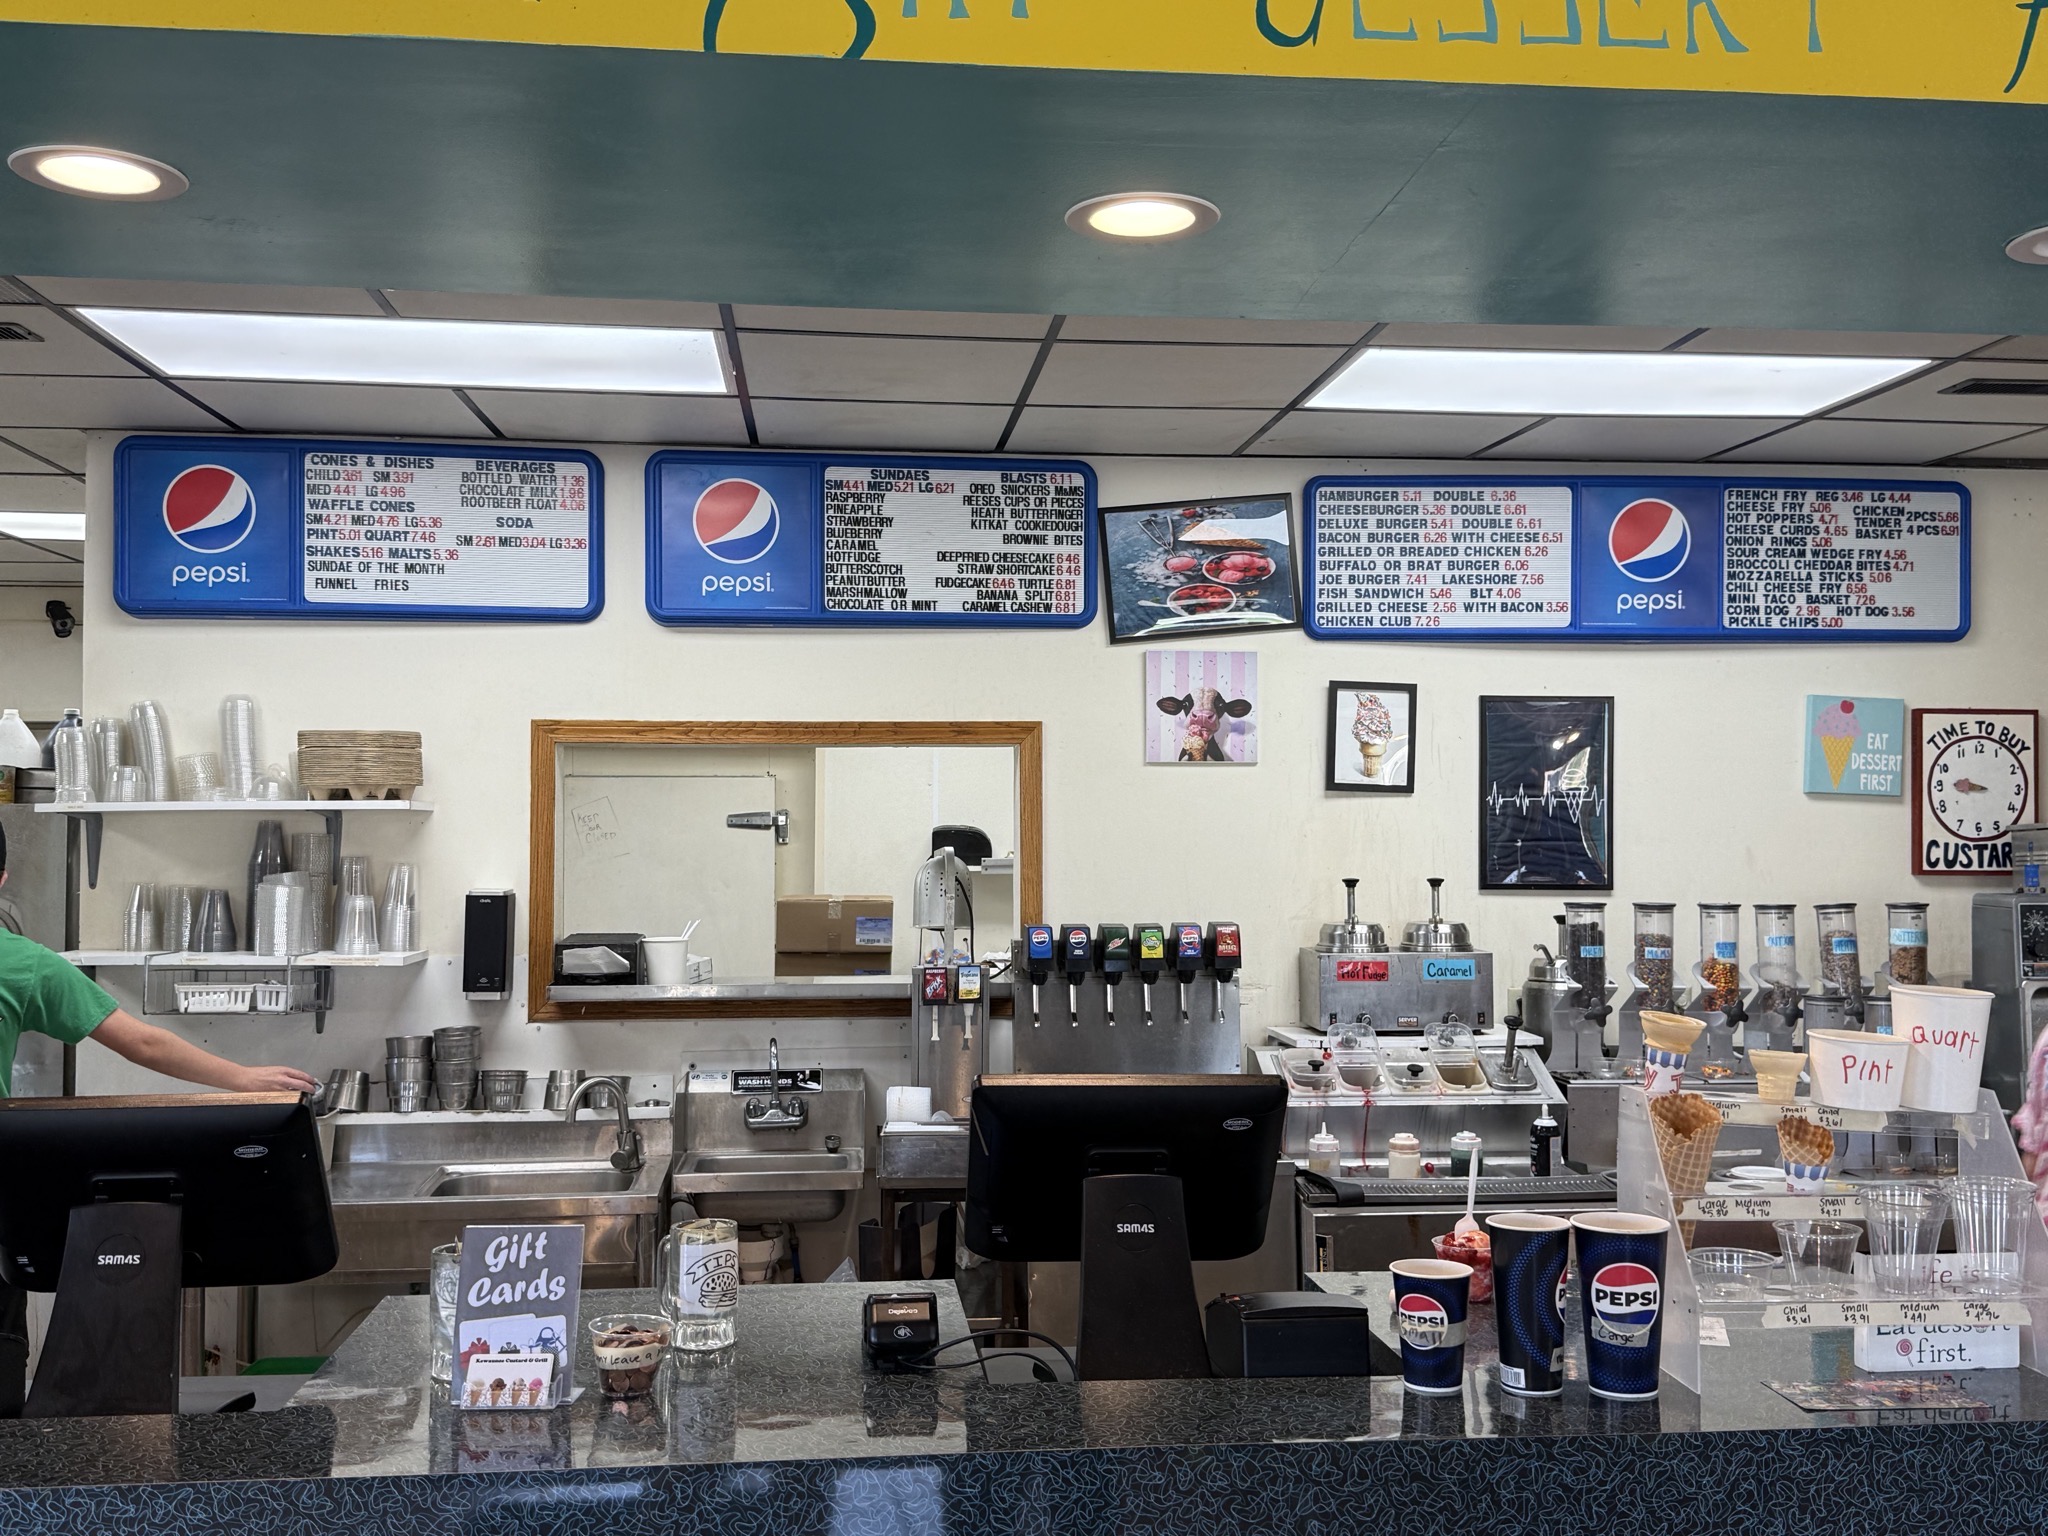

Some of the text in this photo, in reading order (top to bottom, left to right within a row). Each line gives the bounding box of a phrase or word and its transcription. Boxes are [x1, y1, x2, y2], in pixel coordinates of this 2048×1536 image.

[310, 454, 434, 469] CONES & DISHES
[476, 460, 555, 474] BEVERAGES
[870, 469, 930, 481] SUNDAES
[1001, 472, 1047, 484] BLASTS
[969, 483, 1084, 497] OREO SNICKERS M&MS
[1319, 490, 1399, 501] HAMBURGER
[1433, 490, 1485, 501] DOUBLE
[825, 491, 886, 504] RASPBERRY
[963, 495, 1084, 509] REESES CUPS OR PIECES
[308, 499, 415, 512] WAFFLE CONES
[826, 503, 883, 516] PINEAPPLE
[1319, 504, 1419, 515] CHEESEBURGER
[1451, 504, 1501, 515] DOUBLE
[1727, 501, 1775, 512] CHEESE
[1781, 502, 1805, 513] FRY
[496, 517, 534, 529] SODA
[826, 515, 894, 528] STRAWBERRY
[1727, 513, 1751, 524] HOT
[1756, 513, 1814, 524] POPPERS
[307, 528, 338, 540] PINT
[364, 529, 409, 541] QUART
[826, 527, 883, 539] BLUEBERRY
[1726, 524, 1774, 536] CHEESE
[1780, 524, 1820, 536] CURDS
[1318, 532, 1361, 543] BACON
[1367, 532, 1420, 543] BURGER
[1451, 532, 1485, 543] WITH
[1490, 532, 1540, 543] CHEESE
[1725, 536, 1764, 546] ONION
[1770, 536, 1807, 547] RINGS
[826, 539, 879, 551] CARAMEL
[307, 560, 444, 574] SUNDAE OF THE MONTH
[825, 563, 903, 575] BUTTERSCOTCH
[1319, 560, 1377, 571] BUFFALO
[1383, 560, 1402, 571] OR
[1407, 560, 1442, 571] BRAT
[1447, 560, 1500, 571] BURGER
[1727, 559, 1790, 570] BROCCOLI
[1794, 559, 1852, 571] CHEDDAR
[1856, 561, 1891, 571] BITES
[172, 562, 246, 587] pepsi
[825, 575, 906, 587] PEANUTBUTTER
[1318, 574, 1343, 585] JOE
[1348, 574, 1400, 585] BURGER
[1442, 574, 1518, 585] LAKESHORE
[315, 578, 409, 591] FUNNEL FRIES
[702, 572, 771, 596] pepsi
[826, 587, 908, 599] MARSHMALLOW
[826, 599, 938, 611] CHOCOLATE OR MINT
[1617, 589, 1683, 614] pepsi
[1726, 605, 1760, 616] CORN
[1764, 605, 1790, 616] DOG
[1836, 606, 1861, 616] HOT
[1865, 606, 1889, 617] DOG
[1317, 616, 1374, 627] CHICKEN
[1379, 616, 1412, 627] CLUB
[1867, 733, 1889, 750] EAT
[1927, 720, 2031, 756] TIME TO BUY
[1957, 748, 1965, 758] 11
[1975, 744, 1985, 754] 12
[1851, 753, 1902, 770] DESSERT
[1939, 763, 1949, 774] 10
[1860, 773, 1893, 792] FIRST
[1936, 780, 1944, 792] 9
[2014, 784, 2021, 796] 3
[1939, 800, 1947, 813] 8
[1975, 822, 1982, 833] 6
[1925, 839, 2013, 869] CUSTAR
[1362, 965, 1387, 981] Fudge
[1427, 962, 1472, 977] Caramel
[1912, 1026, 1979, 1059] Quart
[1842, 1054, 1893, 1084] Pint
[1698, 1200, 1728, 1210] Large
[1116, 1223, 1155, 1234] SAM4S
[485, 1231, 547, 1273] Gift
[97, 1254, 141, 1266] SAM4S
[697, 1253, 737, 1272] TIPS
[467, 1268, 566, 1308] Cards
[1595, 1288, 1657, 1307] PEPSI
[1783, 1304, 1807, 1315] Child
[1841, 1304, 1869, 1313] Small
[1963, 1302, 1990, 1312] Large
[1401, 1312, 1444, 1328] PEPSI
[1916, 1338, 1972, 1363] first.
